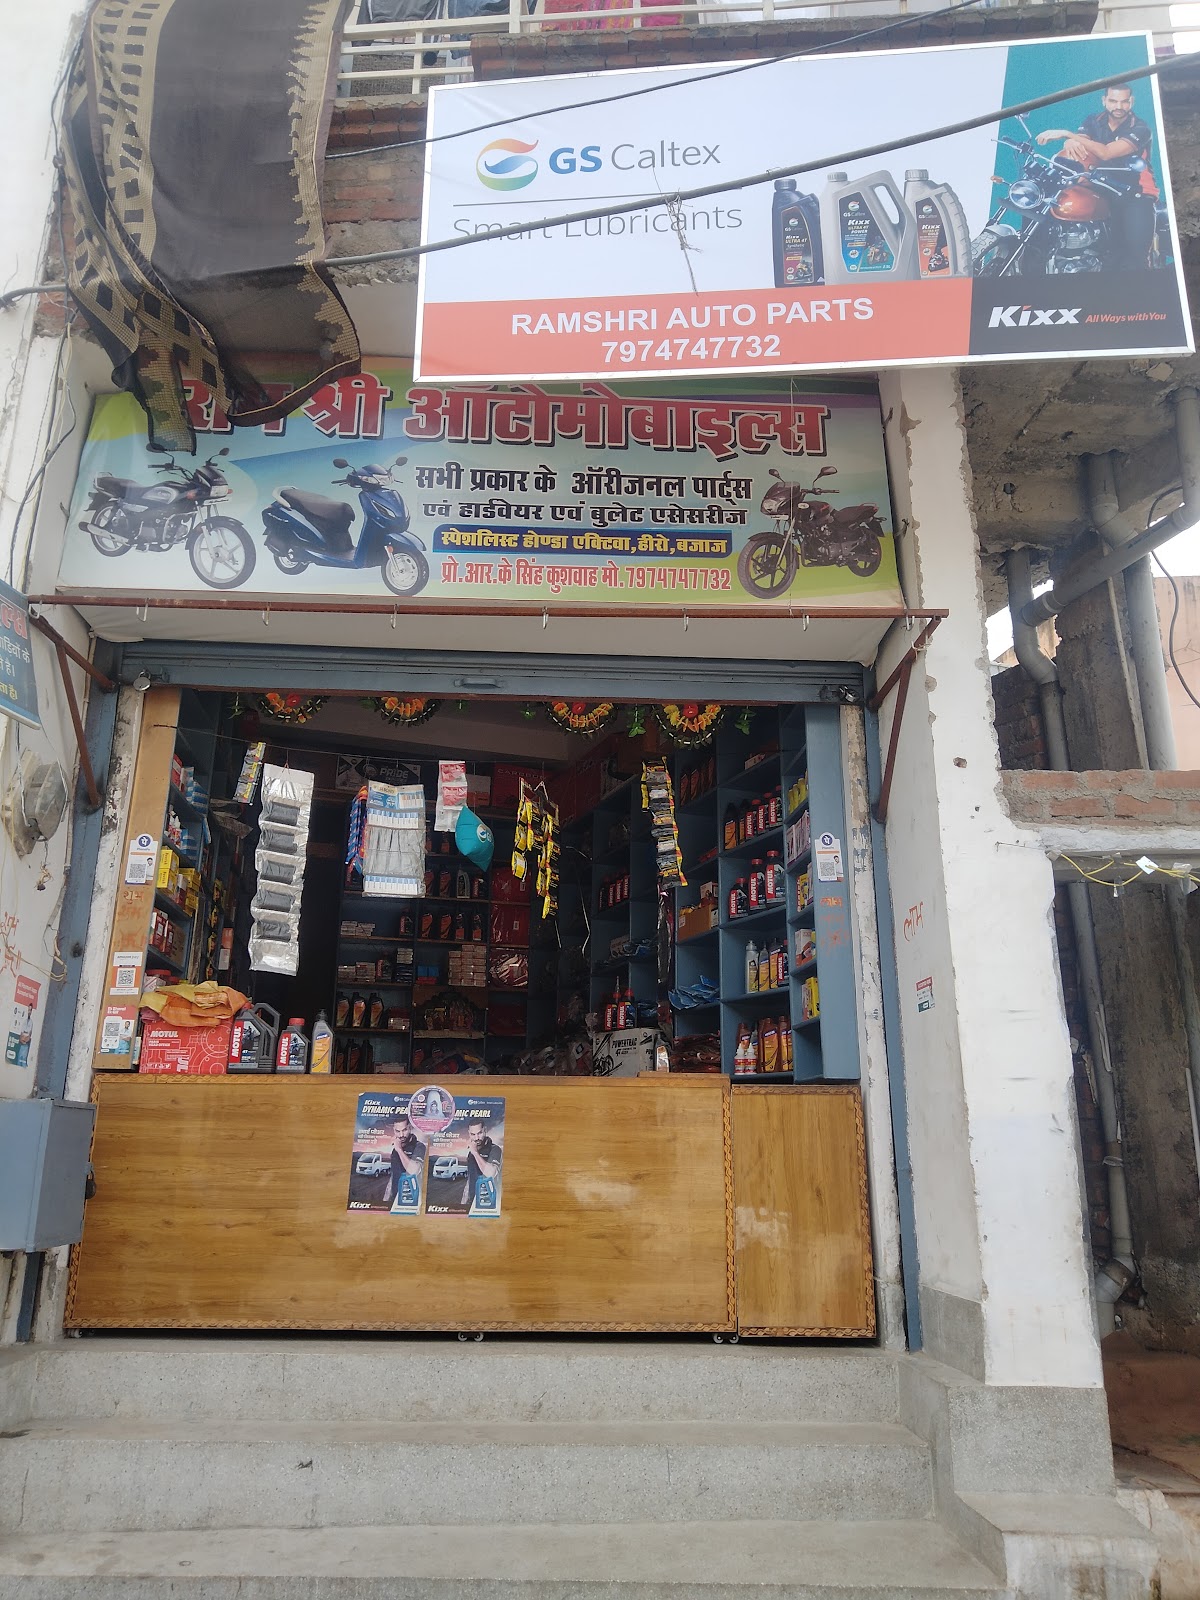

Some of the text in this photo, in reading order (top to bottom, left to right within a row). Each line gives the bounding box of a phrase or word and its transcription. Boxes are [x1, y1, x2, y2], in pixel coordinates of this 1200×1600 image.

[549, 140, 721, 174] GS Caltex
[565, 206, 743, 238] Lubricants
[511, 297, 875, 335] RAMSHRI AUTO PARTS
[988, 305, 1082, 328] Kixx
[1085, 314, 1100, 323] All
[1100, 313, 1126, 324] Ways
[601, 335, 781, 363] 7974747732
[301, 372, 393, 440] श्री
[416, 461, 753, 506] सभी प्रकार के ऑरीजनल पार्ट्स
[423, 499, 452, 518] एवं
[550, 501, 586, 522] एवं
[590, 502, 645, 528] बुलेट
[650, 502, 748, 526] एसेसरीज
[441, 528, 520, 547] स्पेशलिस्ट
[523, 530, 569, 549] होण्डा
[516, 557, 544, 586] सिंह
[546, 564, 599, 594] कुशवाह
[379, 767, 410, 779] PRIDE
[150, 1030, 179, 1038] MOTUL
[231, 1026, 242, 1058] MOTUL
[280, 1037, 289, 1065] MOTUL
[362, 1105, 409, 1115] DYNAMIC PEA
[469, 1109, 491, 1118] PEARL
[349, 1201, 372, 1209] Kixx
[427, 1204, 450, 1213] Kixx
